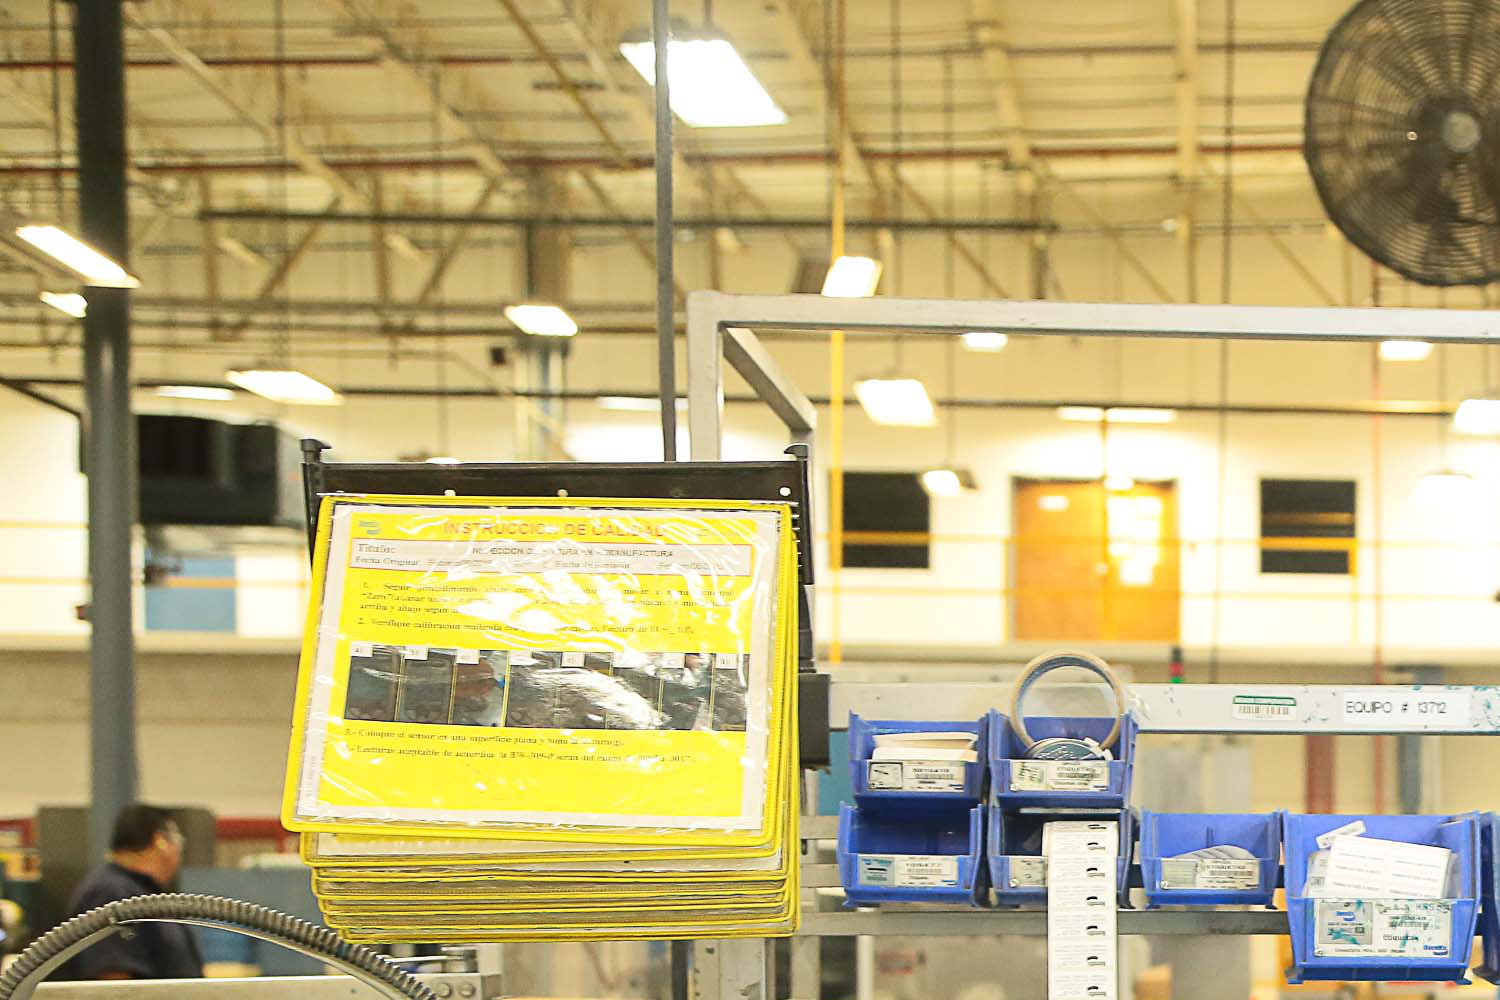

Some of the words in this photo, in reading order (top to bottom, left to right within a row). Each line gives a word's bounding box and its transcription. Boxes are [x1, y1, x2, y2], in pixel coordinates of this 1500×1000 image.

[564, 523, 586, 536] DE
[1345, 700, 1393, 714] EQUIPO
[1401, 702, 1409, 714] #
[1417, 701, 1448, 714] 13712
